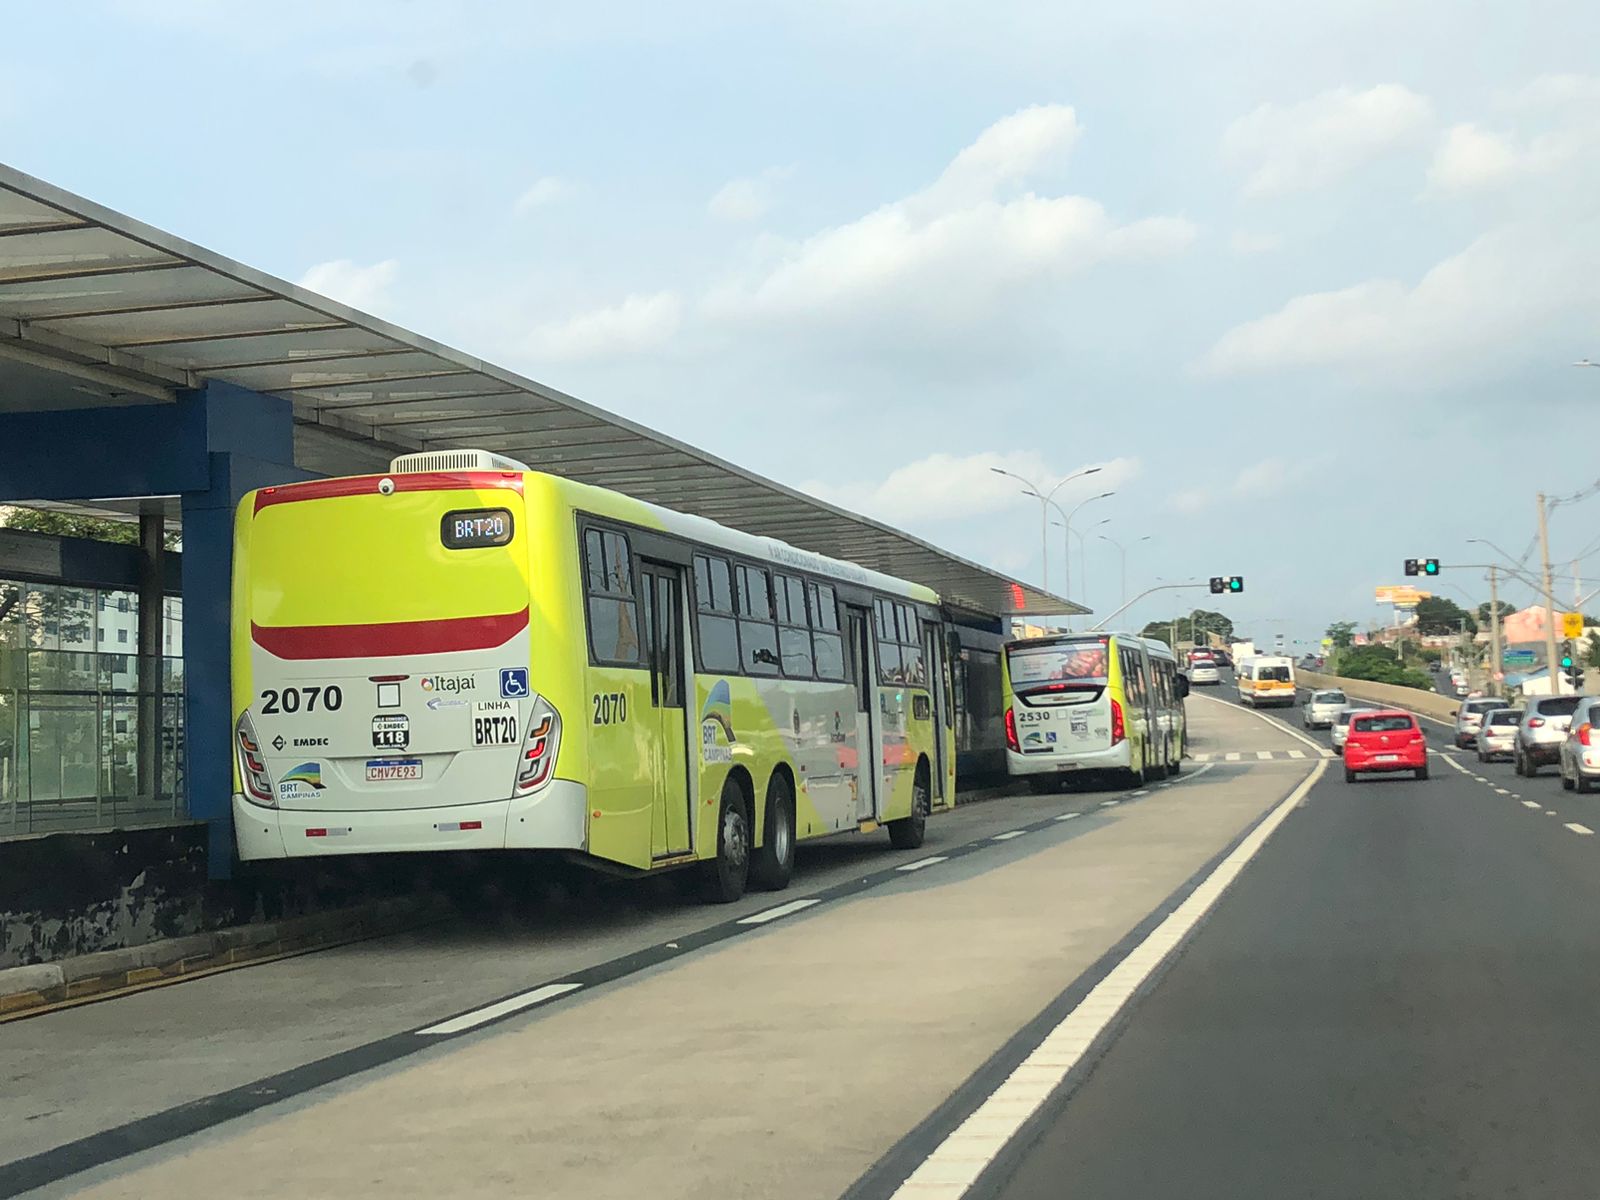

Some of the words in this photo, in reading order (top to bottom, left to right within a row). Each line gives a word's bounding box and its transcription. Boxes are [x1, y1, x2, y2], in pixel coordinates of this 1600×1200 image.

[455, 517, 503, 538] BRT20
[435, 674, 475, 694] Itajaí
[261, 685, 342, 714] 2070
[478, 701, 511, 711] LINHA
[593, 693, 626, 725] 2070
[1019, 711, 1050, 721] 2530
[474, 716, 517, 744] BRT20
[703, 725, 716, 744] BRT
[293, 738, 329, 747] EMDEC
[377, 731, 405, 744] 118
[370, 766, 416, 779] CMV7E93
[280, 783, 298, 793] BRT
[280, 791, 321, 800] CAMPINAS
